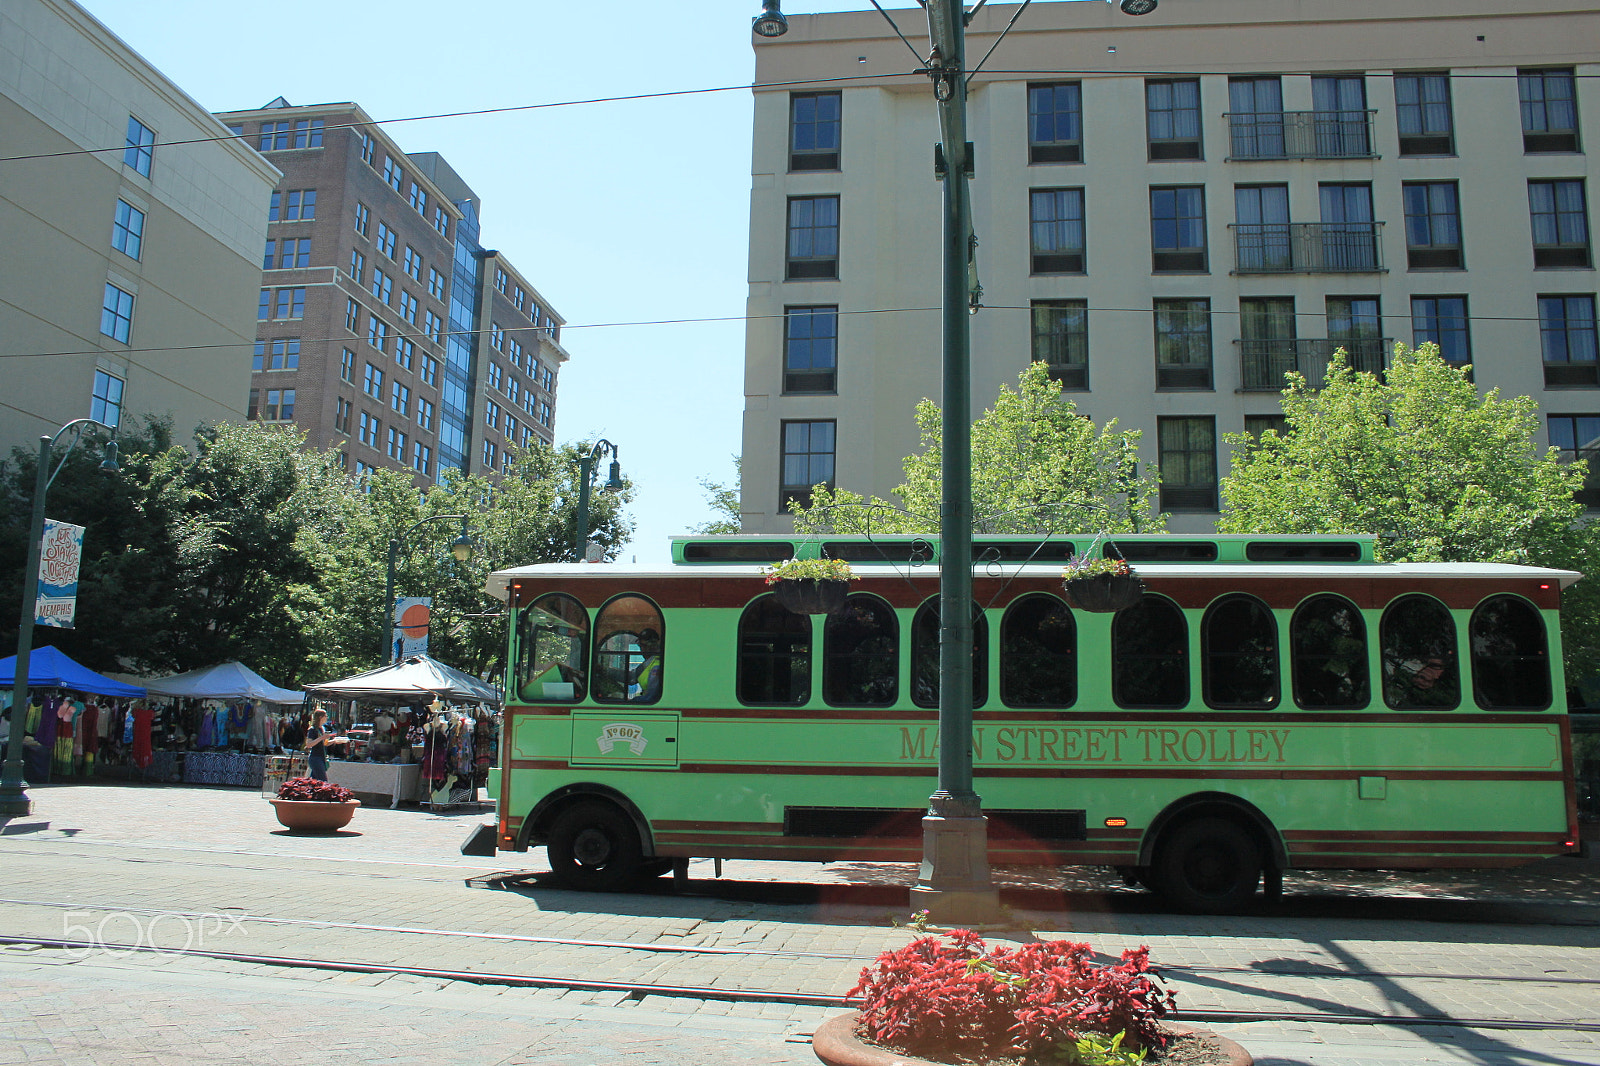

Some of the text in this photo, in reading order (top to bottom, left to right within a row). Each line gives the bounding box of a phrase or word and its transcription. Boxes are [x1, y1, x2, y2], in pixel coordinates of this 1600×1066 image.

[46, 538, 77, 563] STAY
[39, 603, 72, 617] MEMPHIS
[619, 727, 641, 739] 607
[996, 727, 1129, 762] STREET
[1136, 728, 1291, 763] TROLLEY
